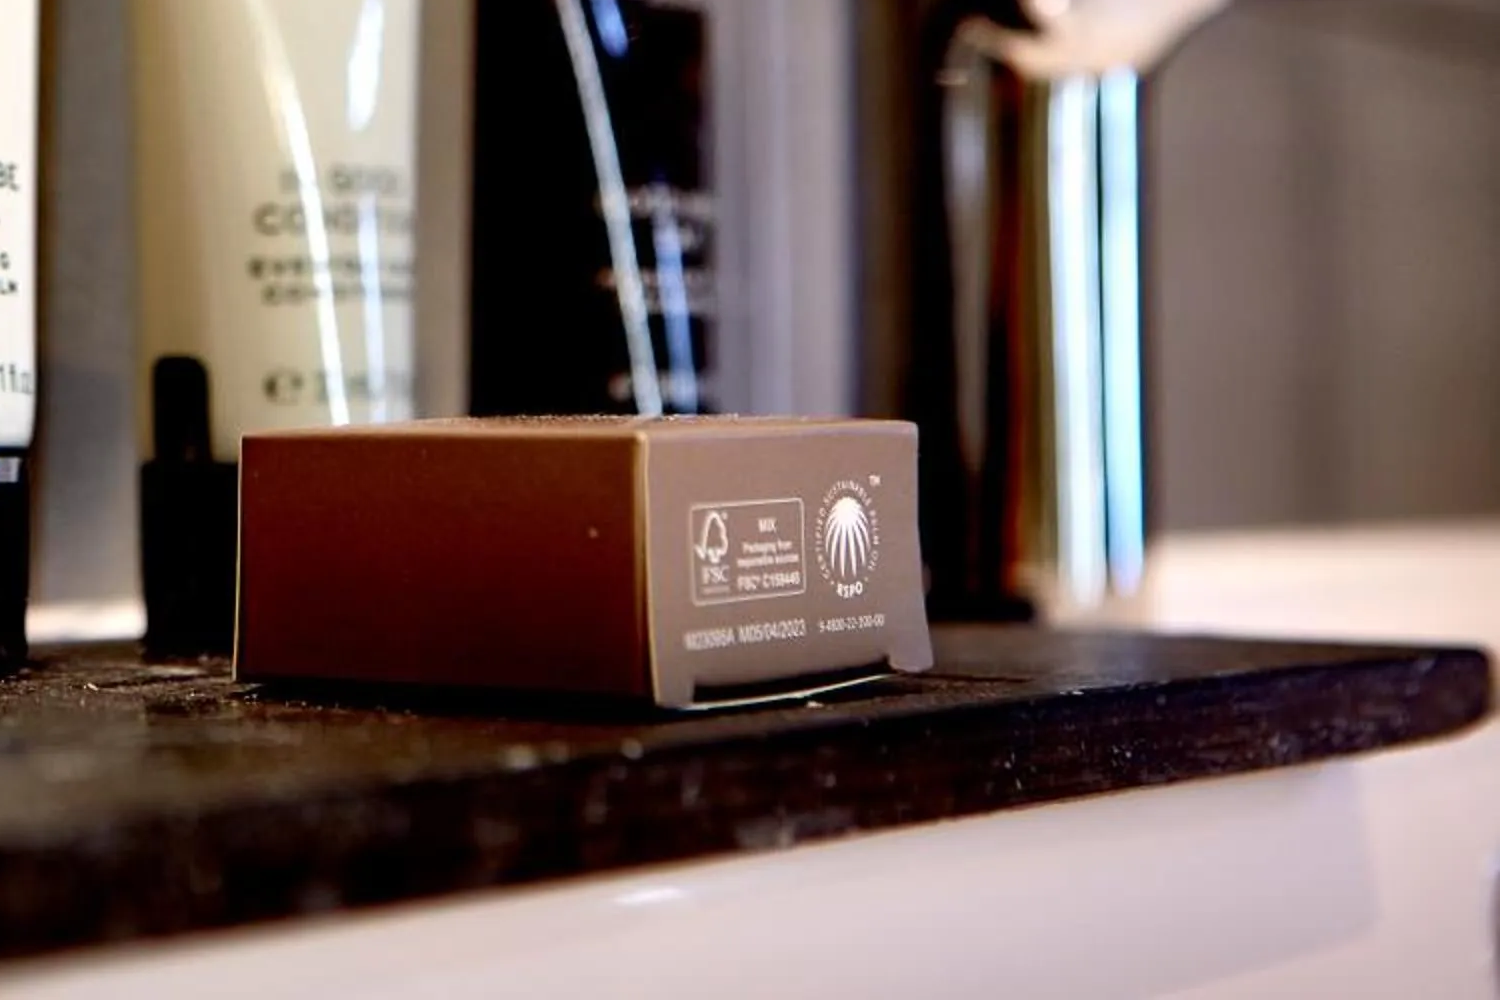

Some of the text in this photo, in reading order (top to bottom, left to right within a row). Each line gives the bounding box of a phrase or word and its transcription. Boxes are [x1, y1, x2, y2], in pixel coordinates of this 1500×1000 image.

[757, 517, 778, 533] MIX
[702, 564, 731, 585] FSC
[835, 581, 864, 599] RSPO
